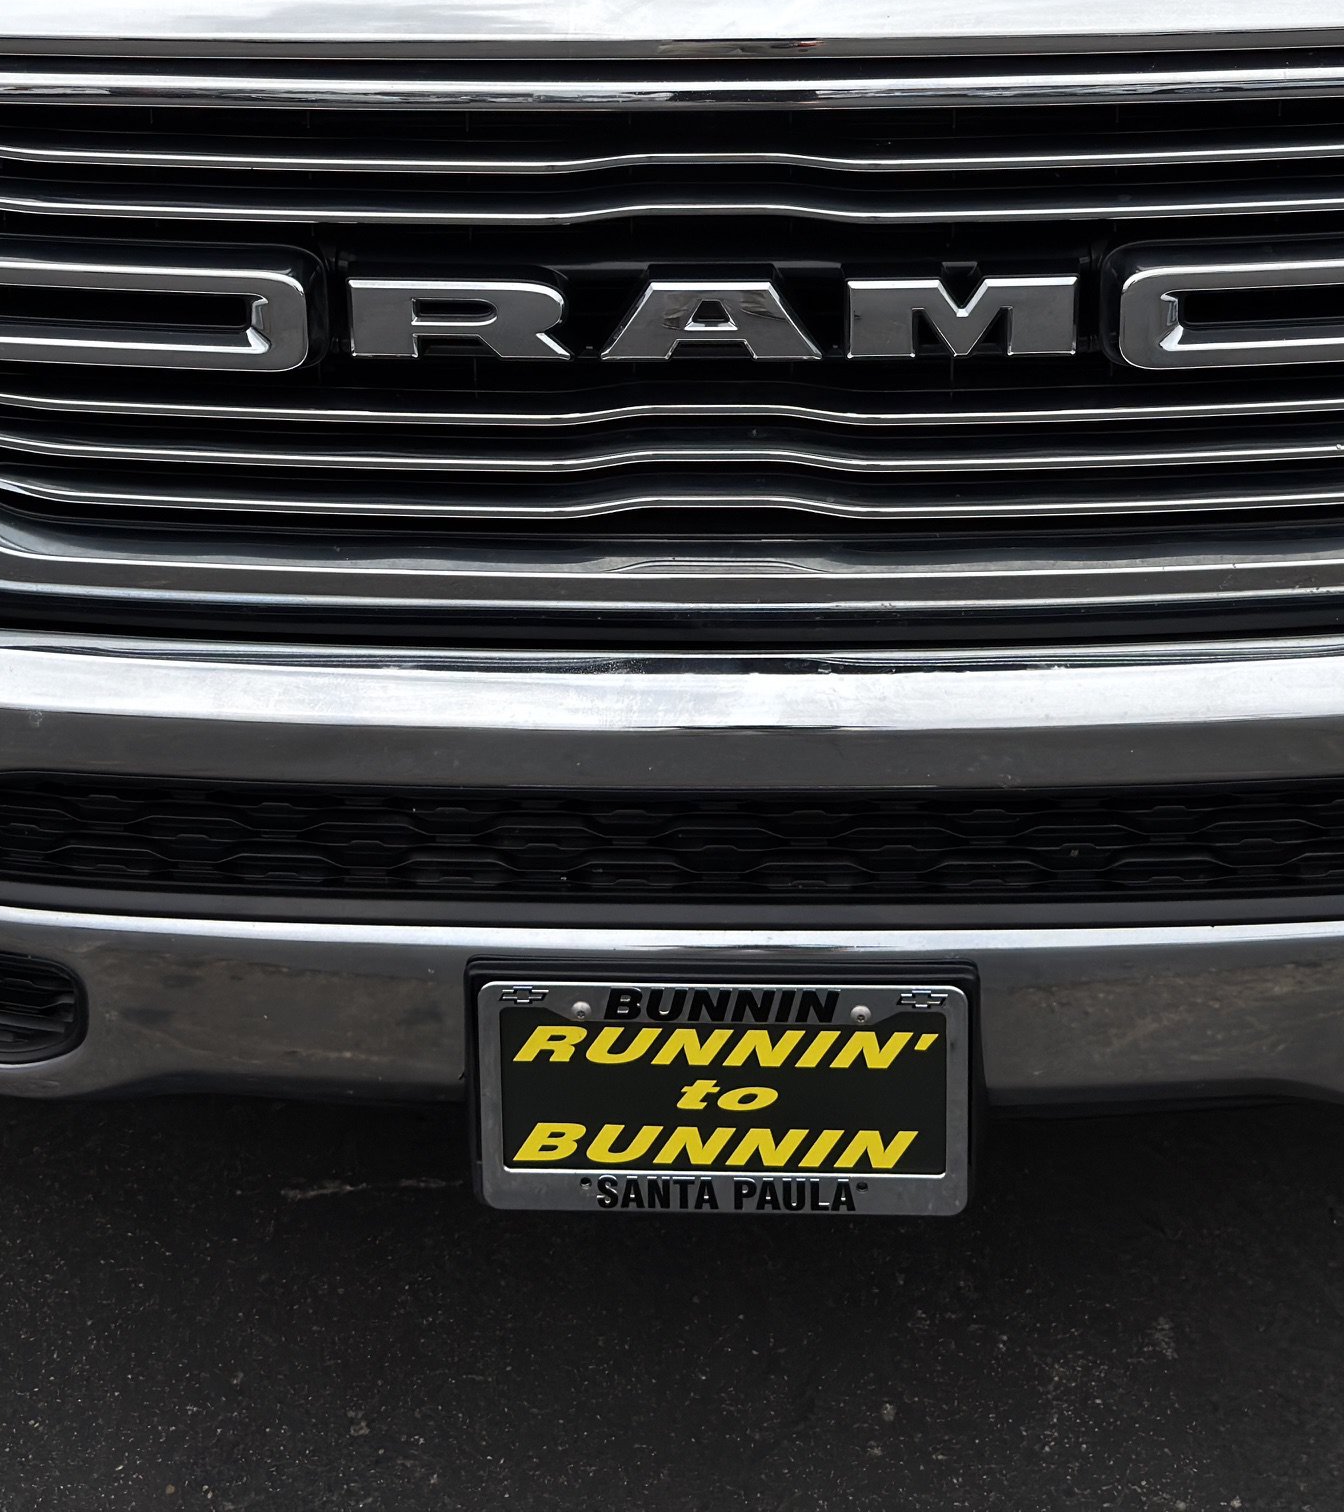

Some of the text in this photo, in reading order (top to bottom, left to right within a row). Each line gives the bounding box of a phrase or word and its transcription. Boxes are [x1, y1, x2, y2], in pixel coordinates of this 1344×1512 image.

[348, 276, 1077, 361] RAM
[603, 986, 842, 1023] BUNNIN
[512, 1025, 940, 1070] RUNNIN'
[676, 1079, 779, 1112] to
[512, 1121, 920, 1169] BUNNIN
[597, 1174, 856, 1213] SANTA PAULA
